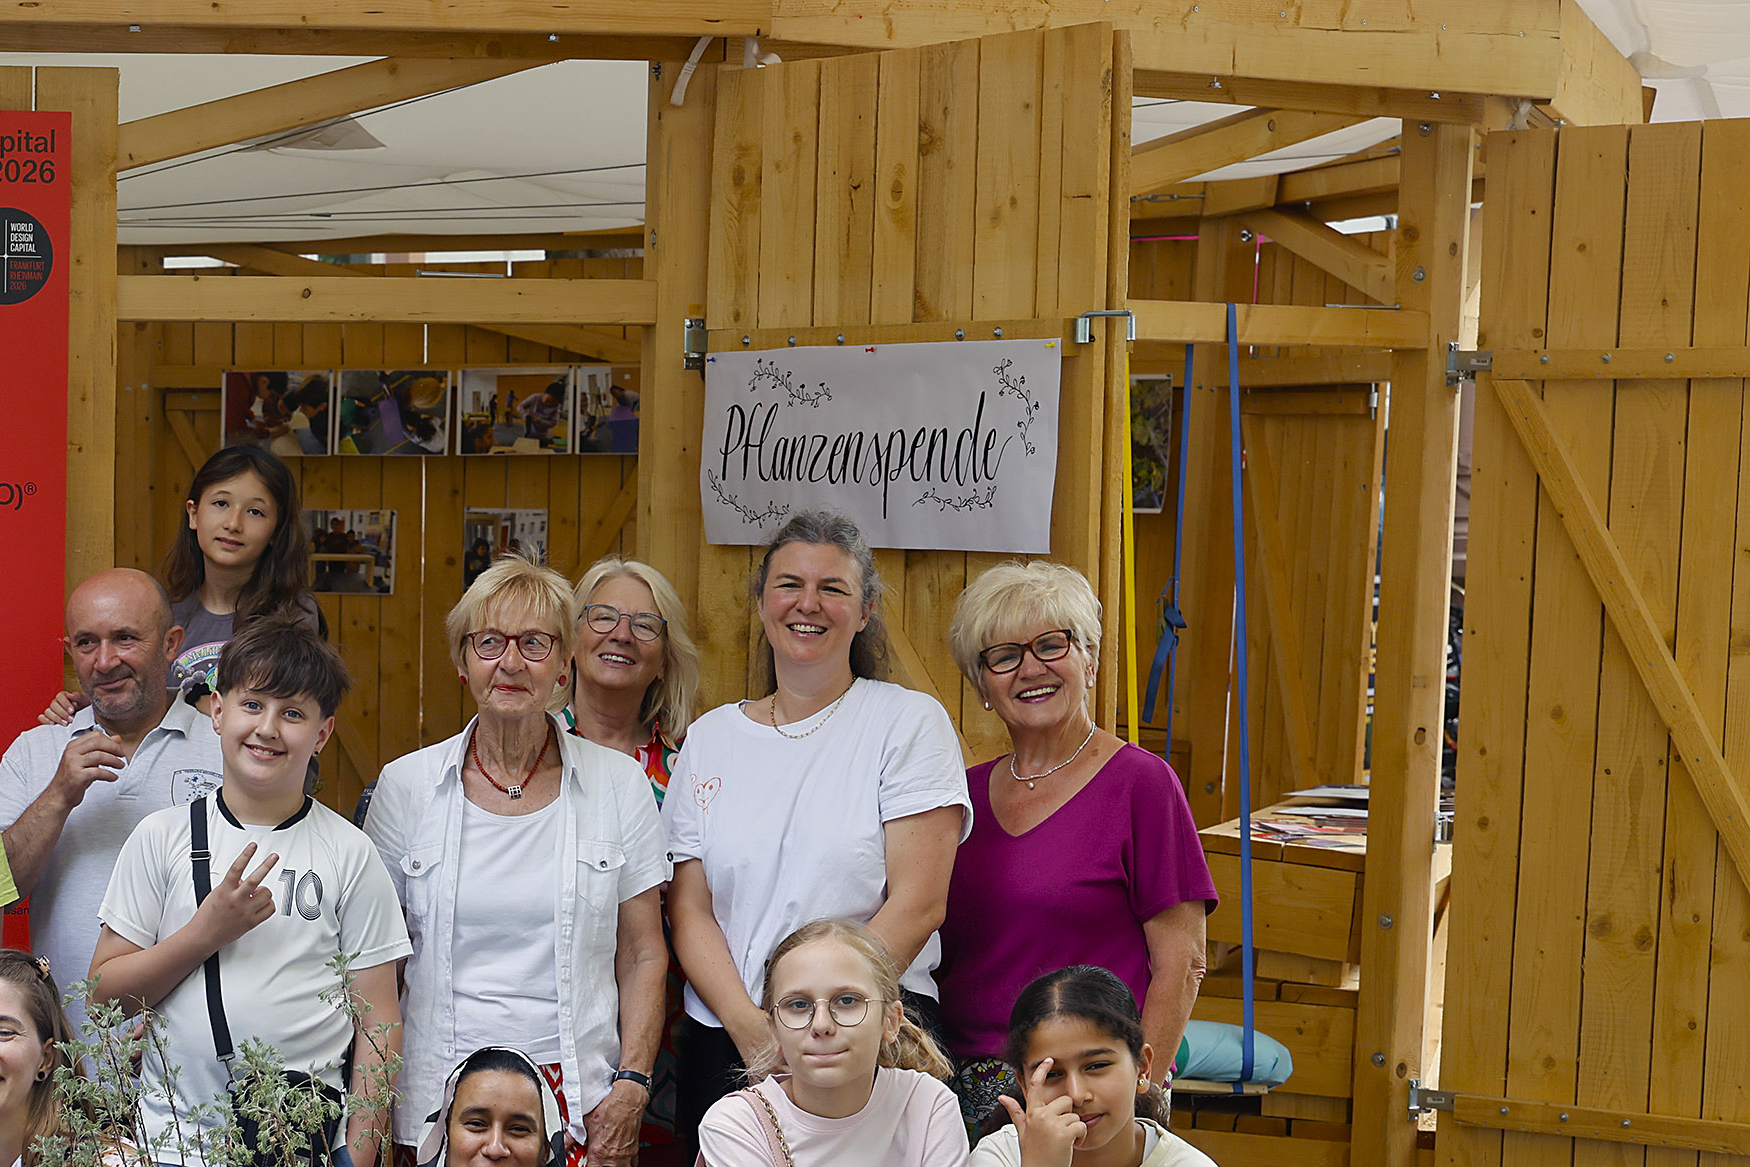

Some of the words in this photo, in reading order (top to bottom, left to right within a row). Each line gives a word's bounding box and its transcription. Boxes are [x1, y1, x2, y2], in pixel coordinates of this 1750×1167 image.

[10, 222, 34, 233] WORLD
[10, 233, 34, 243] DESIGN
[10, 243, 37, 253] CAPITAL
[720, 391, 1013, 519] Pflanzenspende
[278, 868, 323, 921] 10
